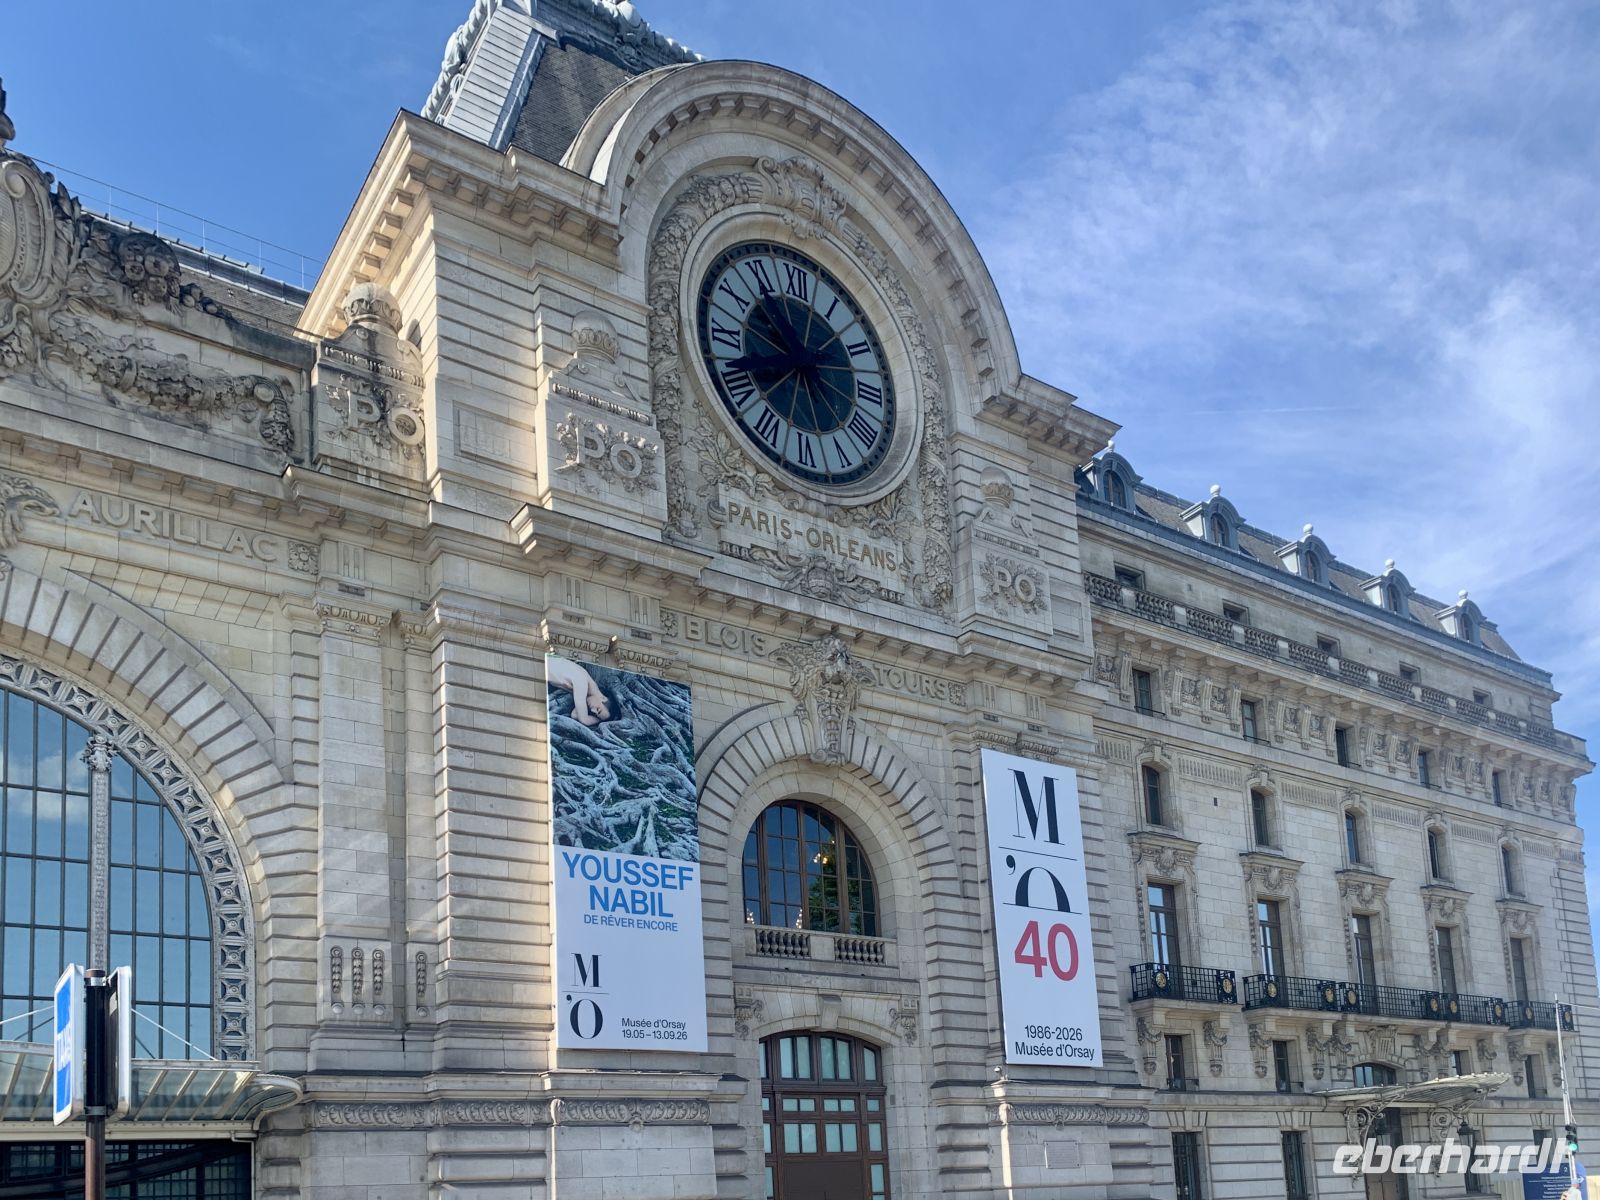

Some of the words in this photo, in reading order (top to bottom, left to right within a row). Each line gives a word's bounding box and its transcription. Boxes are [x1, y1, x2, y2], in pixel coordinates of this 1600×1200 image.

[719, 278, 749, 314] X
[783, 263, 808, 302] XII
[824, 296, 840, 321] I
[712, 317, 741, 352] IX
[846, 339, 872, 358] II
[856, 379, 882, 408] III
[753, 405, 780, 449] VII
[848, 409, 878, 450] IIII
[797, 431, 817, 468] VI
[833, 436, 852, 468] V
[67, 490, 278, 561] AURILLAC
[727, 501, 897, 572] PARIS-ORLEANS
[684, 615, 766, 657] BLOIS
[872, 663, 948, 700] TOURS
[562, 851, 694, 891] YOUSSEF
[589, 884, 674, 918] NABIL
[583, 914, 599, 925] DE
[600, 914, 635, 929] RÊVER
[637, 919, 679, 932] ENCORE
[1014, 920, 1079, 982] 40
[621, 1017, 652, 1028] Musée
[653, 1018, 686, 1031] d'Orsay
[1024, 1024, 1083, 1041] 1986-2026
[1015, 1041, 1053, 1056] Musée
[1055, 1043, 1095, 1061] d'Orsay
